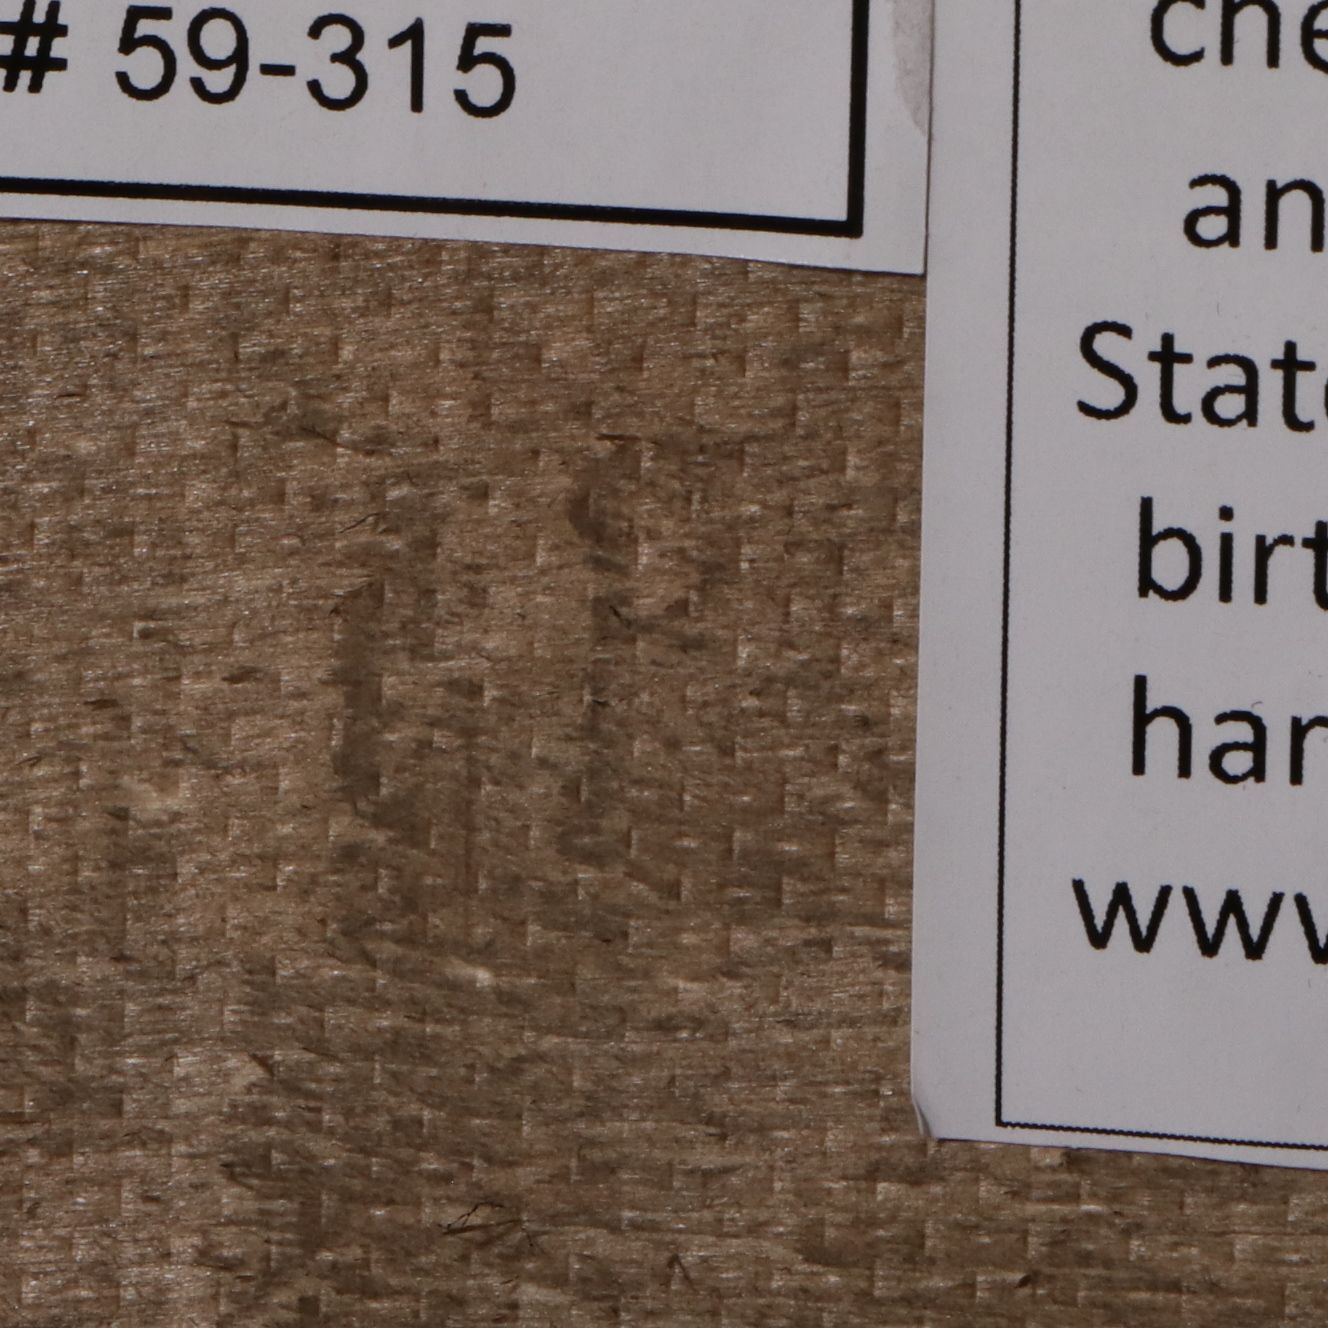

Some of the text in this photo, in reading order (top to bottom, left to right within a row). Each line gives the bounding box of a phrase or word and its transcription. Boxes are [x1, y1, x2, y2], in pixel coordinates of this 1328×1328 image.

[113, 3, 517, 120] 59-315
[1182, 172, 1327, 254] an
[1075, 319, 1328, 434] Stat
